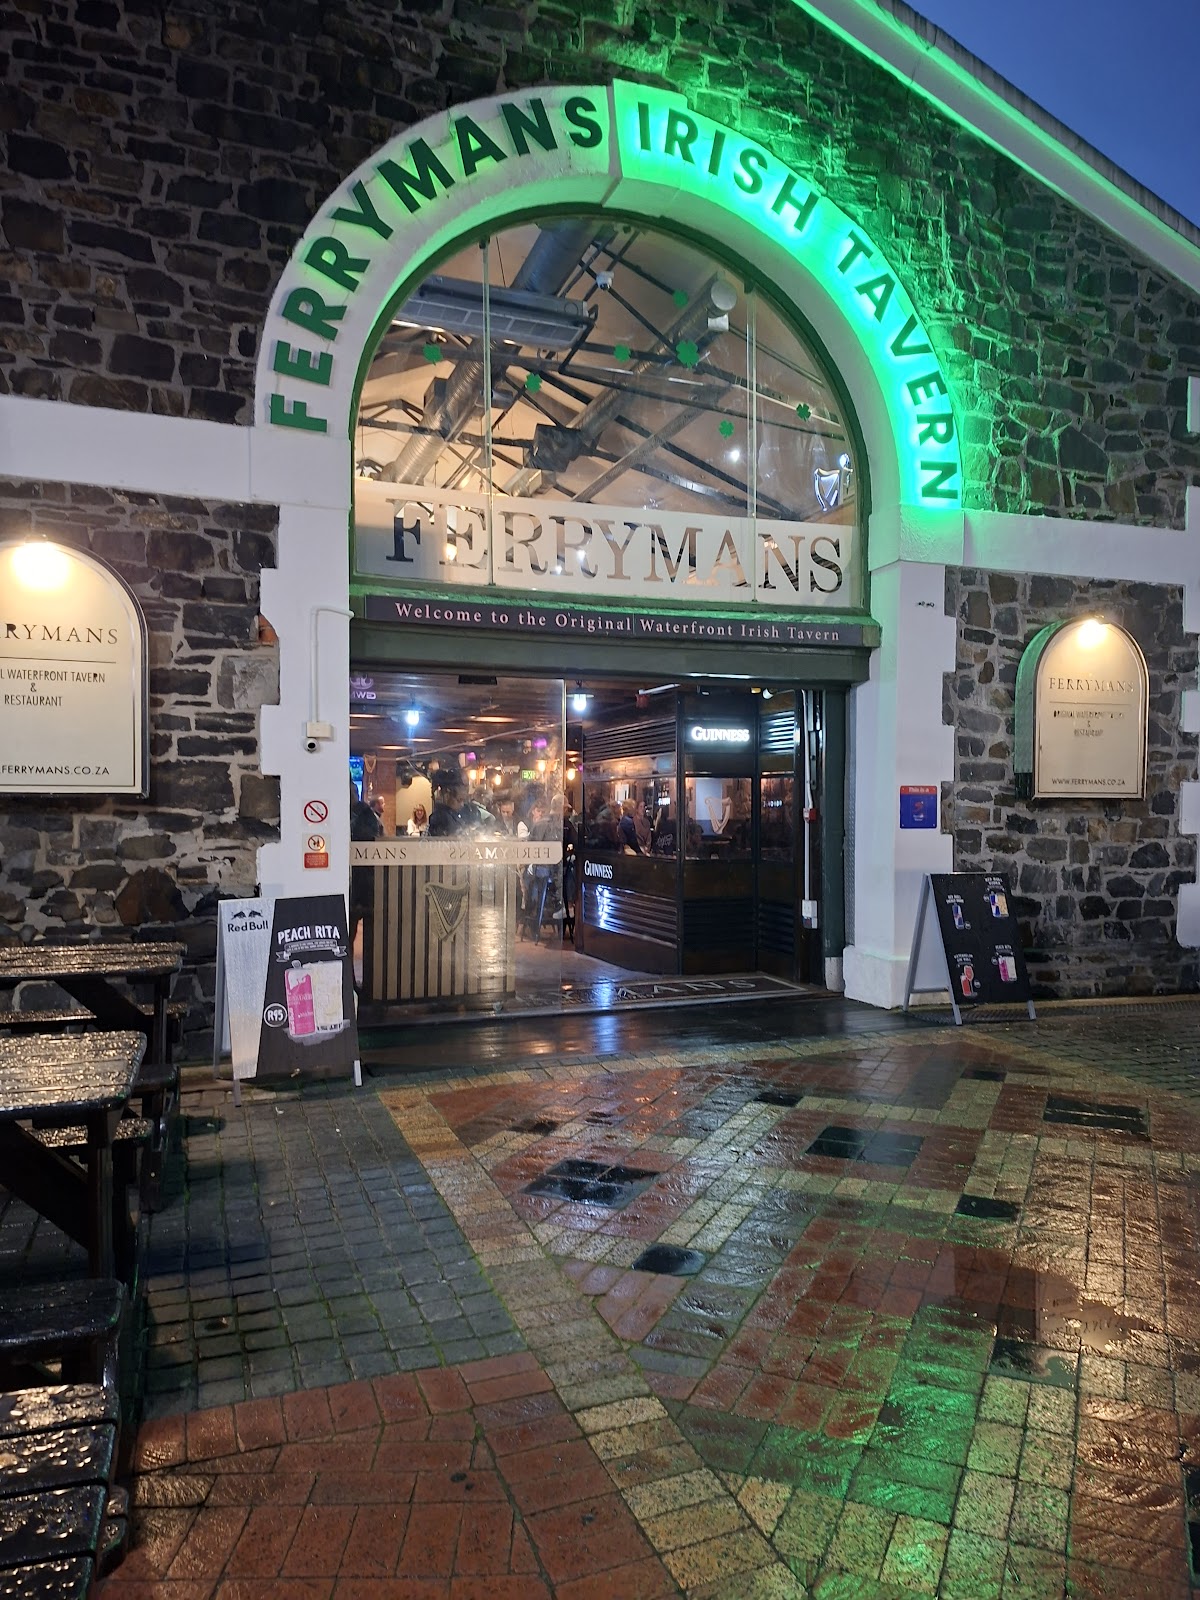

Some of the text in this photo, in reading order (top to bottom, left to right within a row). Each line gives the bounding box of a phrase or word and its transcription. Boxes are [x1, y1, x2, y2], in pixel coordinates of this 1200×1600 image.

[270, 97, 959, 506] FERRYMANS IRISH TAVERN
[385, 497, 843, 594] FERRYMANS
[395, 602, 840, 642] Welcome to the Original Waterfront Irish Tavern
[0, 622, 118, 645] RYMANS
[7, 669, 68, 682] WATERFRONT
[71, 671, 105, 683] TAVERN
[1049, 677, 1135, 693] FERRYMANS
[30, 682, 37, 693] &
[4, 694, 63, 706] RESTAURANT
[227, 920, 269, 932] Red Bull
[277, 924, 341, 945] PEACH RITA
